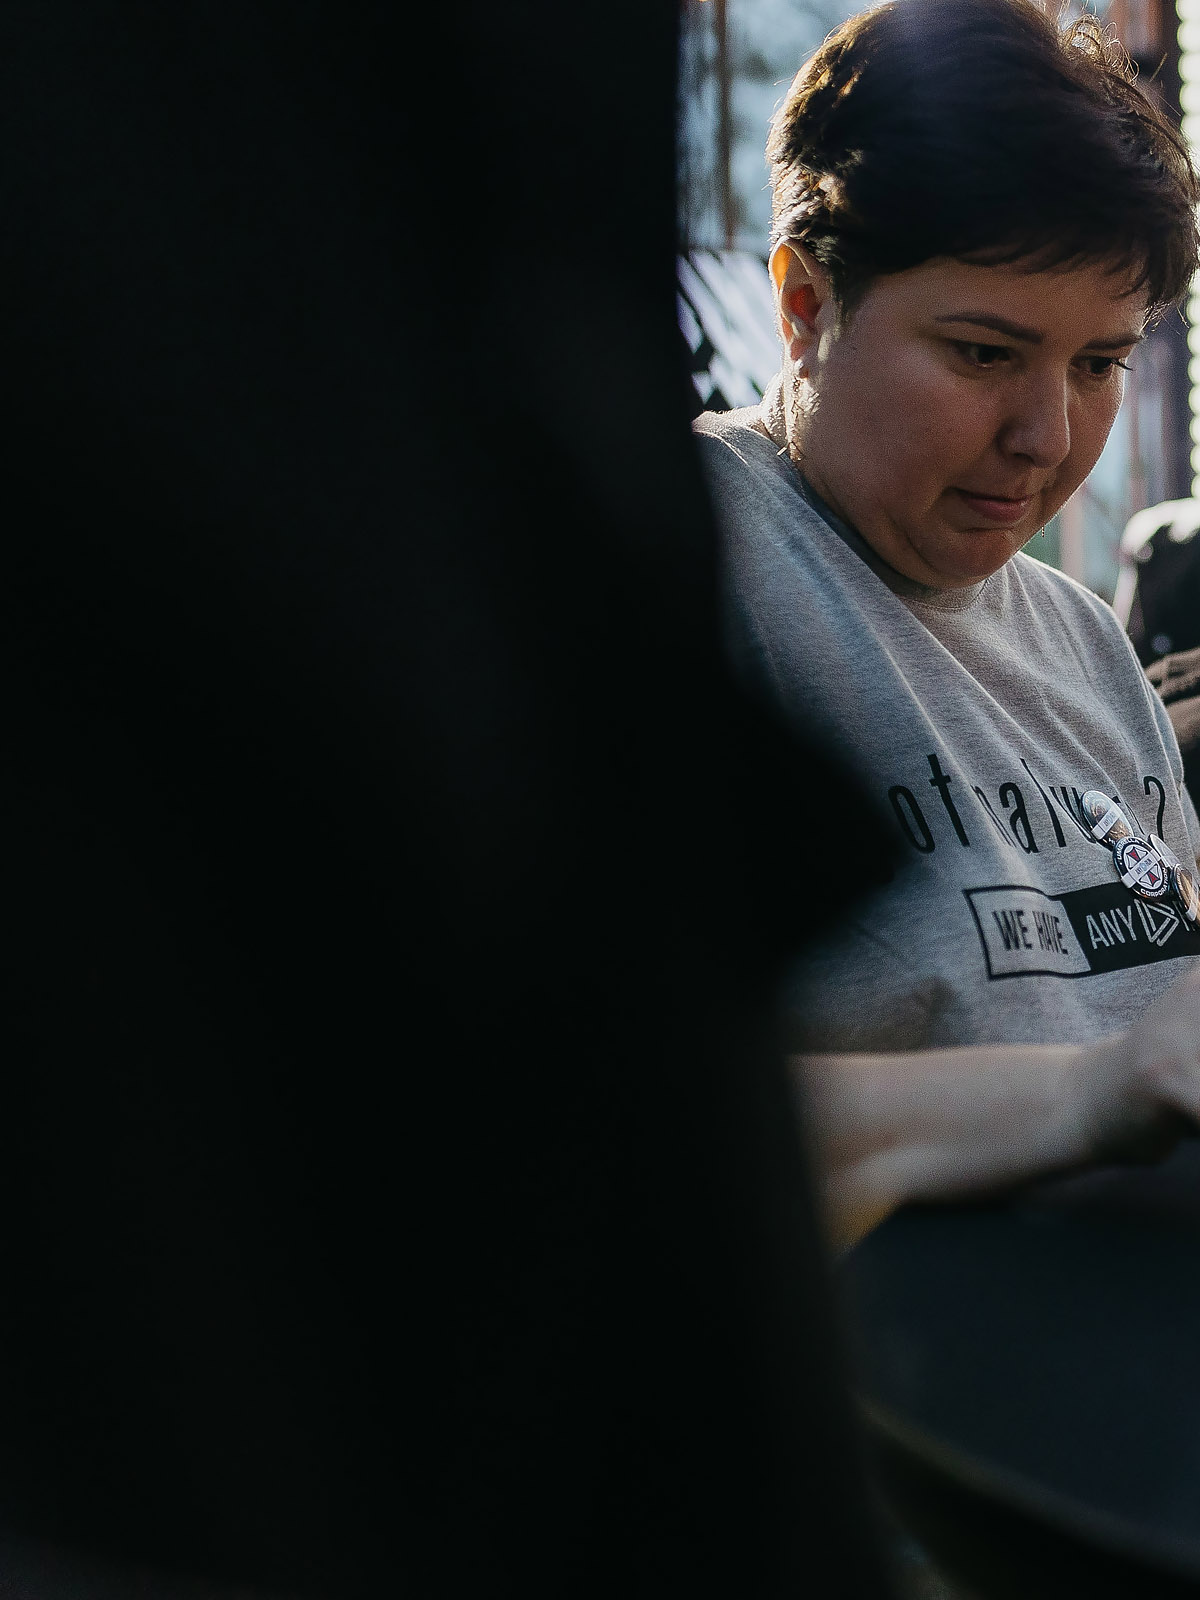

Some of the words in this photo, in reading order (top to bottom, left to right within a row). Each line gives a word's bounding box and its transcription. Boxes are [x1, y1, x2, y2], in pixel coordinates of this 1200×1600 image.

[888, 754, 970, 854] ot
[992, 910, 1032, 951] WE
[1033, 910, 1068, 954] HAVE
